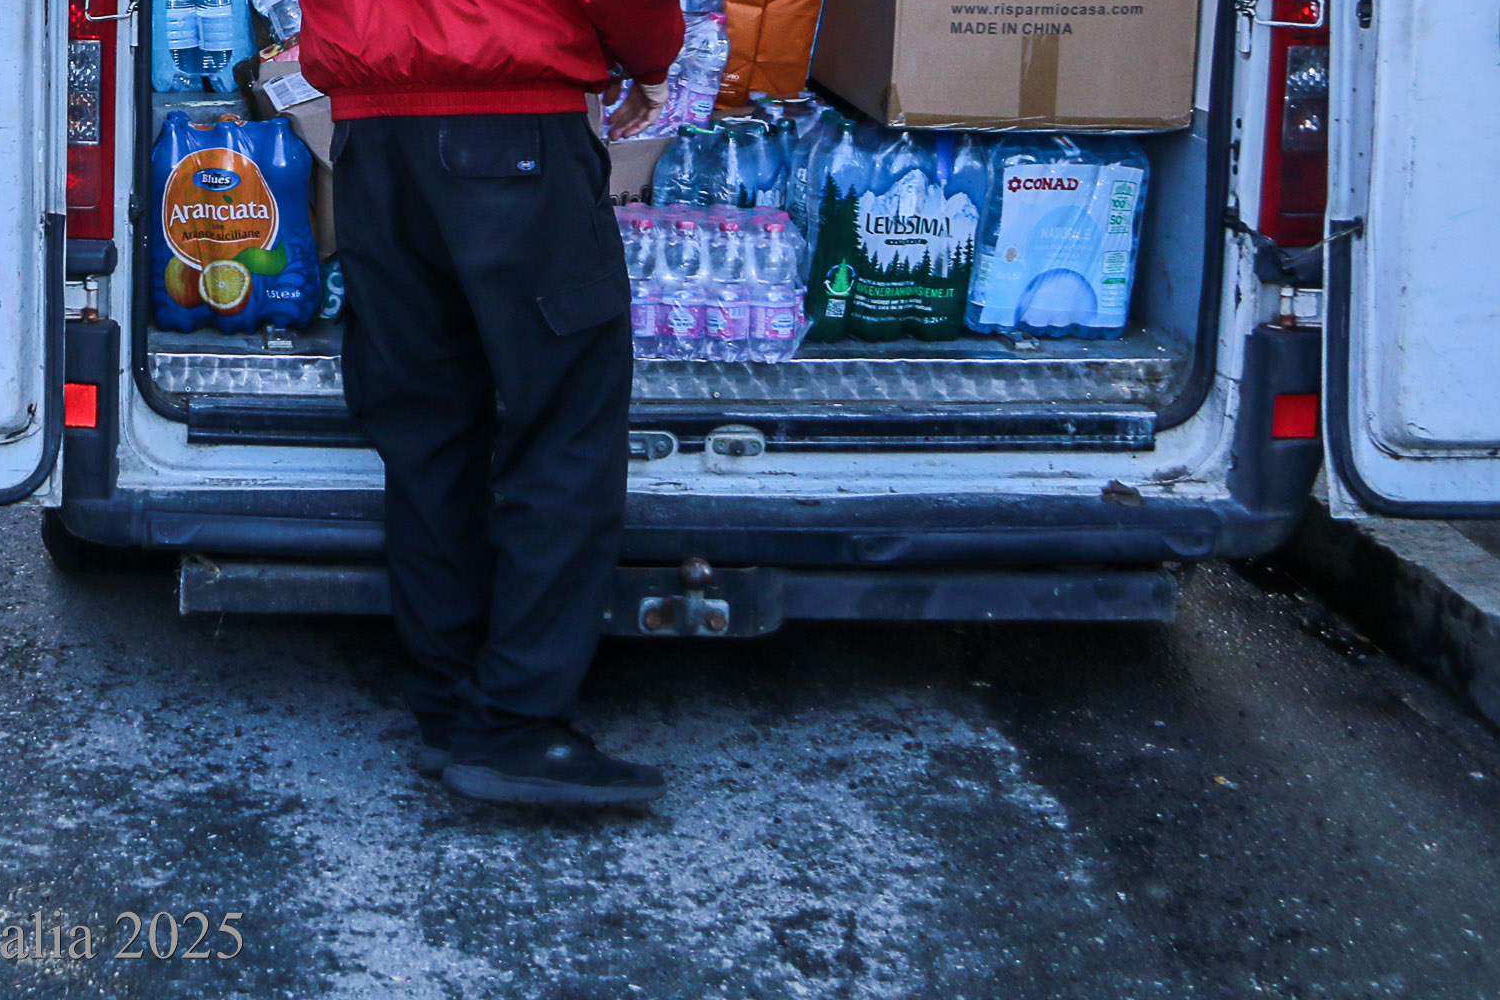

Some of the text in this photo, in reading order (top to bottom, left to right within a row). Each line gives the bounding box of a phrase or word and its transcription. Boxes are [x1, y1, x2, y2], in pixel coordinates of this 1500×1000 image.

[952, 3, 1144, 18] www.risparmiocasa.com
[950, 22, 1074, 36] MADE IN CHINA
[202, 174, 231, 184] Blues
[1023, 178, 1080, 191] CONAD
[170, 201, 270, 227] Aranciata
[182, 229, 260, 241] Arance siciliane
